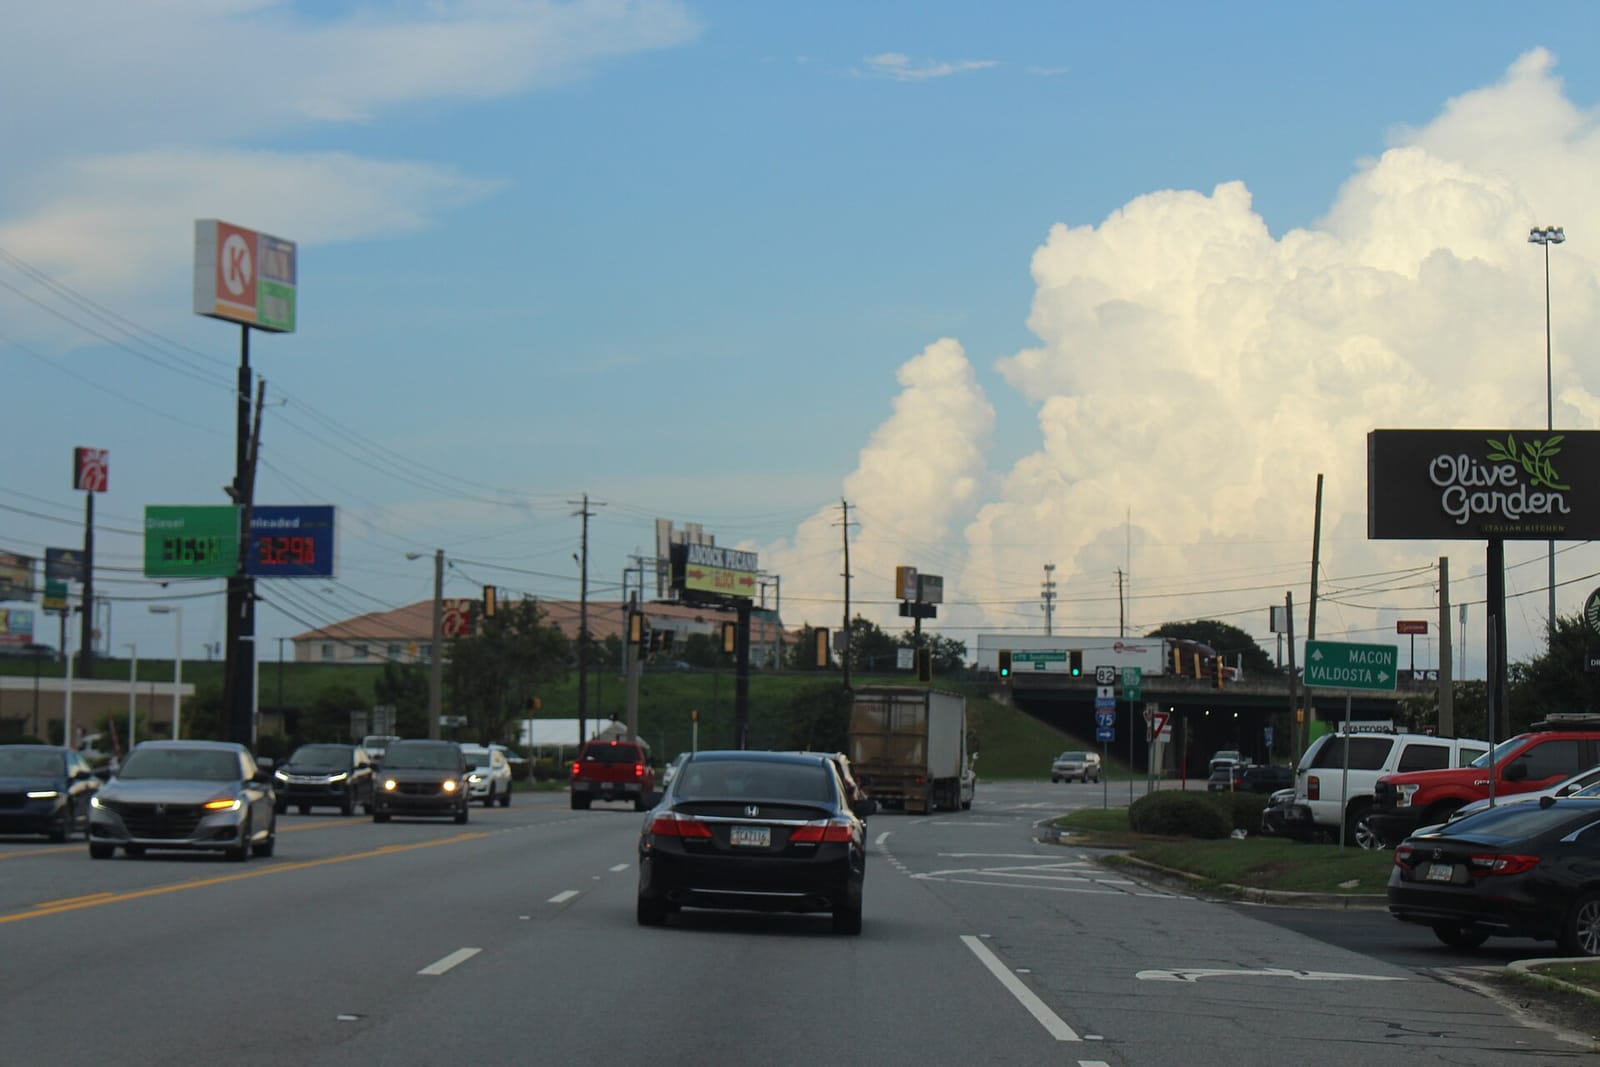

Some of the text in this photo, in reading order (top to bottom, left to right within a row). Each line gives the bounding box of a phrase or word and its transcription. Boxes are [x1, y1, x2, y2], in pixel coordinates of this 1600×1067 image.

[1429, 454, 1518, 487] Olive
[1442, 484, 1571, 525] Garden
[1485, 523, 1566, 532] ITALIAN KITCHEN
[1349, 649, 1392, 665] MACON
[1098, 670, 1113, 681] 82
[1310, 665, 1372, 683] VALDOSTA
[1098, 714, 1113, 726] 75
